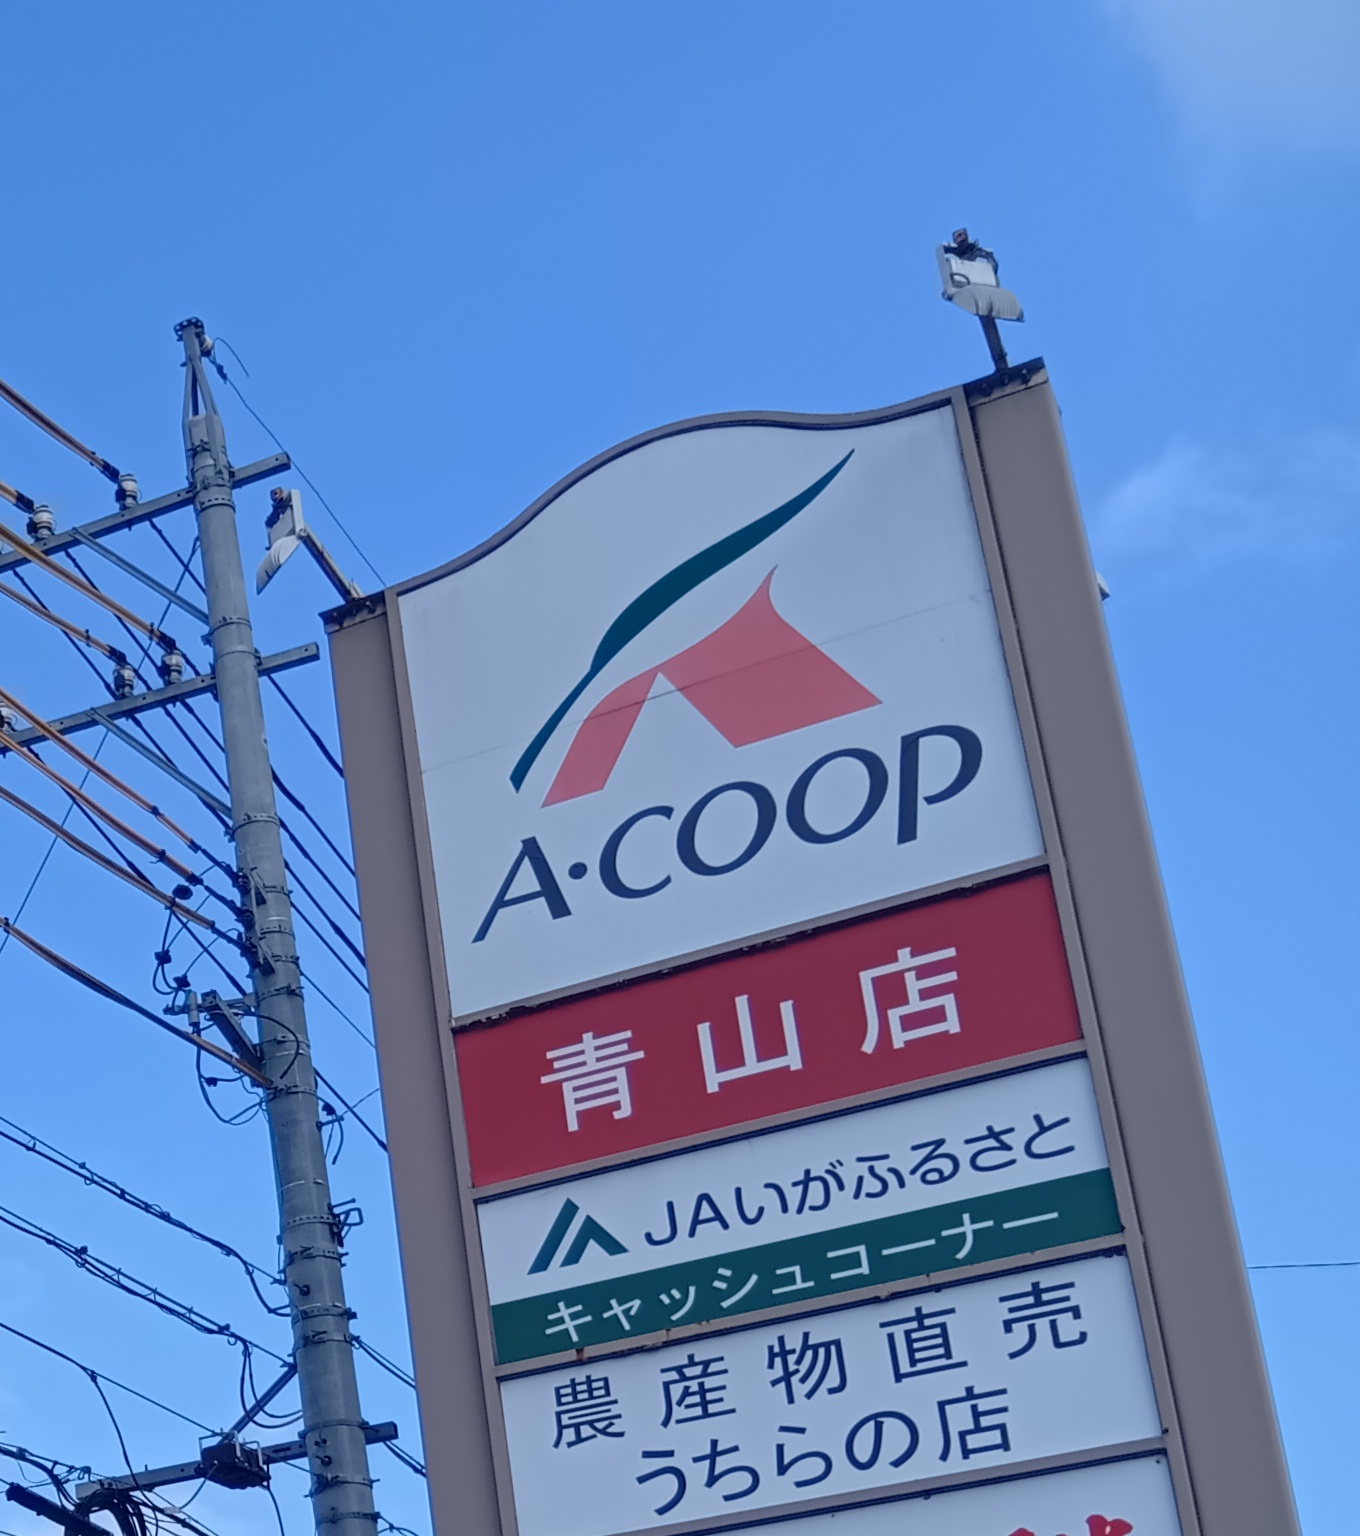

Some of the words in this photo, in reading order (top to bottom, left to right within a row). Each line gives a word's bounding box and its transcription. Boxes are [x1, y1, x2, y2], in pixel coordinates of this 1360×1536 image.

[539, 946, 964, 1133] 青山店
[643, 1111, 1077, 1249] JAいがふるさと
[543, 1210, 1060, 1345] キャッシュコーナー
[551, 1280, 1088, 1450] 農産物直売
[634, 1385, 1013, 1516] うちらの店
